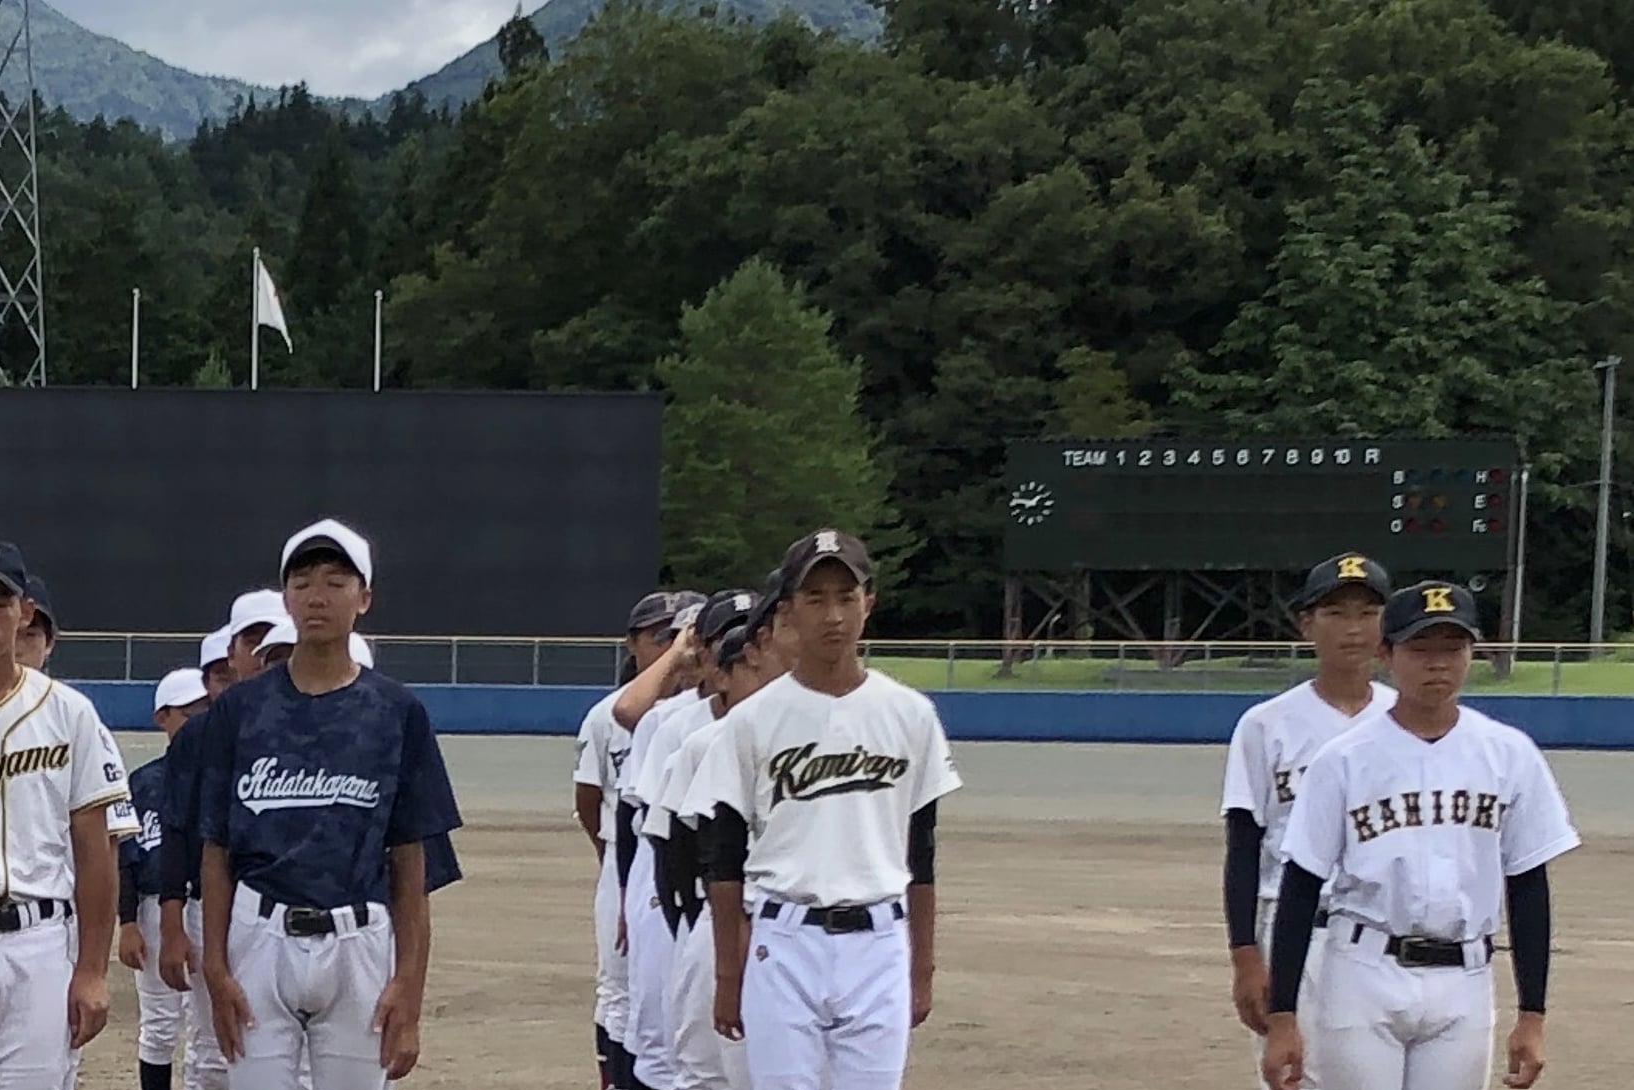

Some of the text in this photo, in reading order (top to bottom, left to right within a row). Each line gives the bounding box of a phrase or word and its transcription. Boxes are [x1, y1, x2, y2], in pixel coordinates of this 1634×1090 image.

[1062, 449, 1380, 466] TEAM 1 2 3 4 5 6 7 8 9 10 R
[1475, 470, 1487, 483] H
[1474, 495, 1486, 509] E
[1337, 556, 1368, 579] K
[1421, 587, 1456, 613] K
